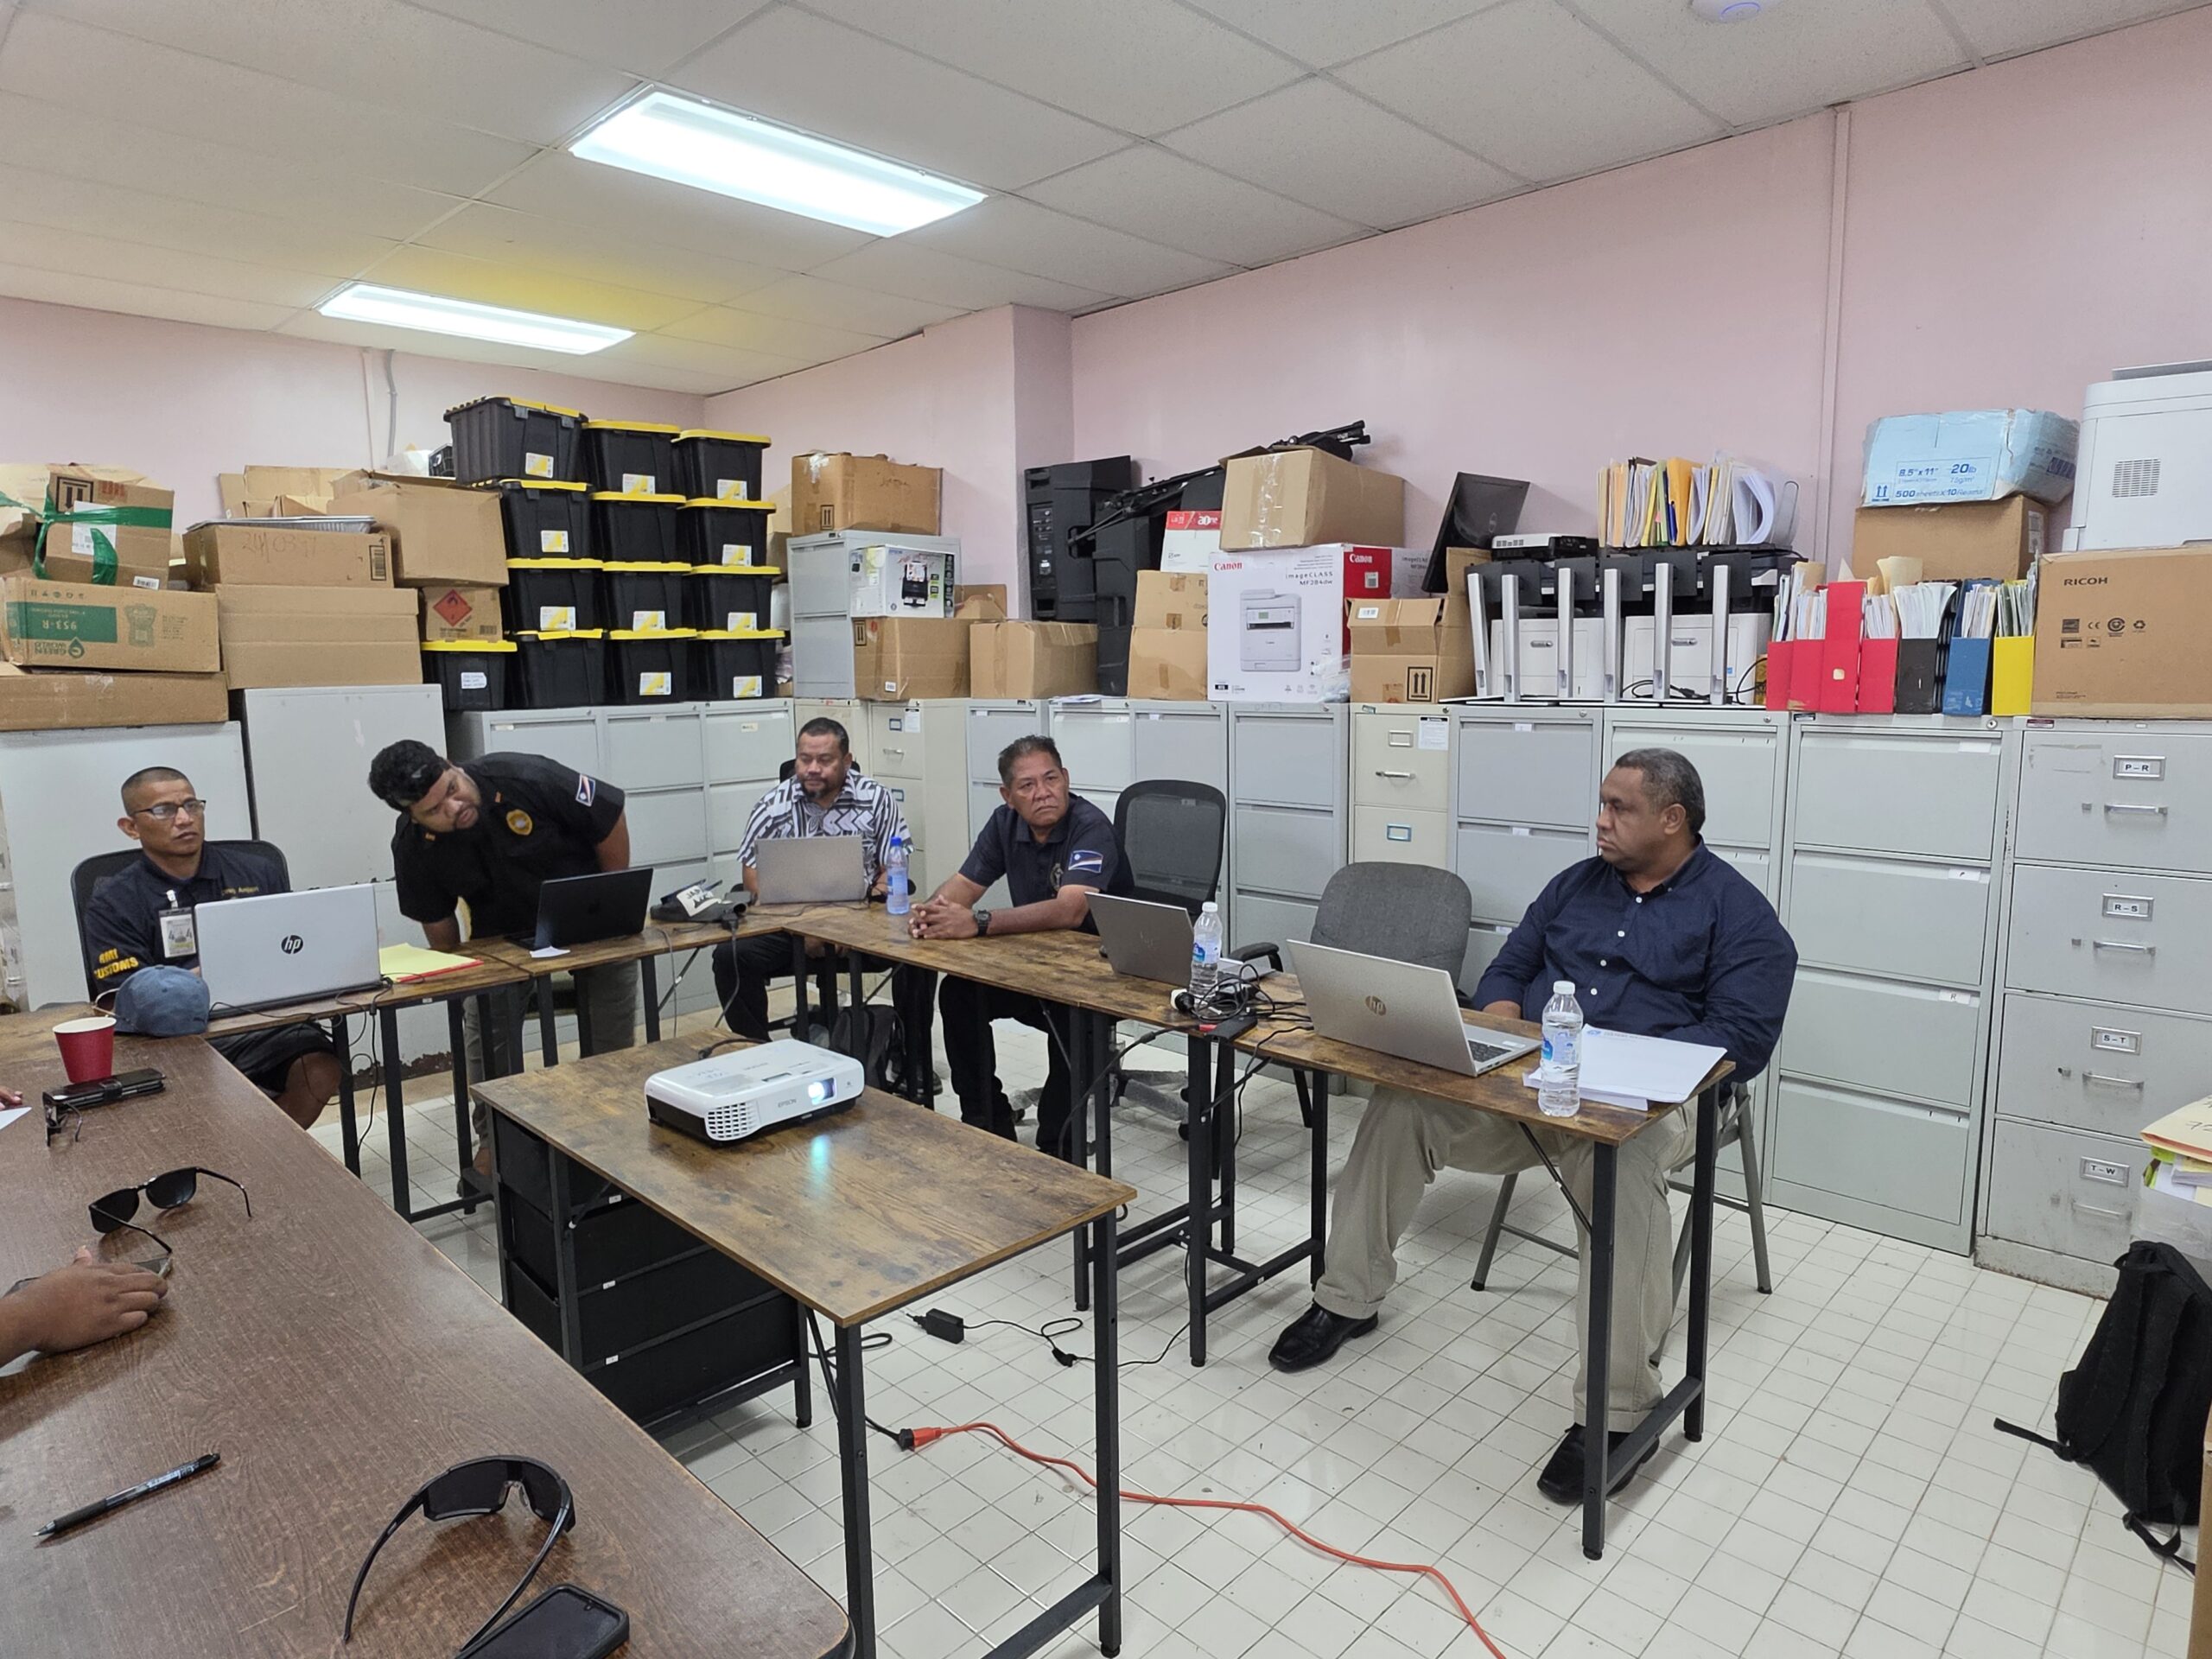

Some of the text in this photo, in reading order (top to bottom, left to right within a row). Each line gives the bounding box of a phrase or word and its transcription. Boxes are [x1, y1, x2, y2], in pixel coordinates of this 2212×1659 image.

[1895, 489, 1916, 498] 500
[1349, 553, 1373, 563] Canon
[1213, 562, 1243, 571] Canon
[2063, 577, 2108, 586] RICOH
[283, 934, 303, 955] hp
[1366, 995, 1386, 1016] hp
[778, 1098, 798, 1109] EPSON
